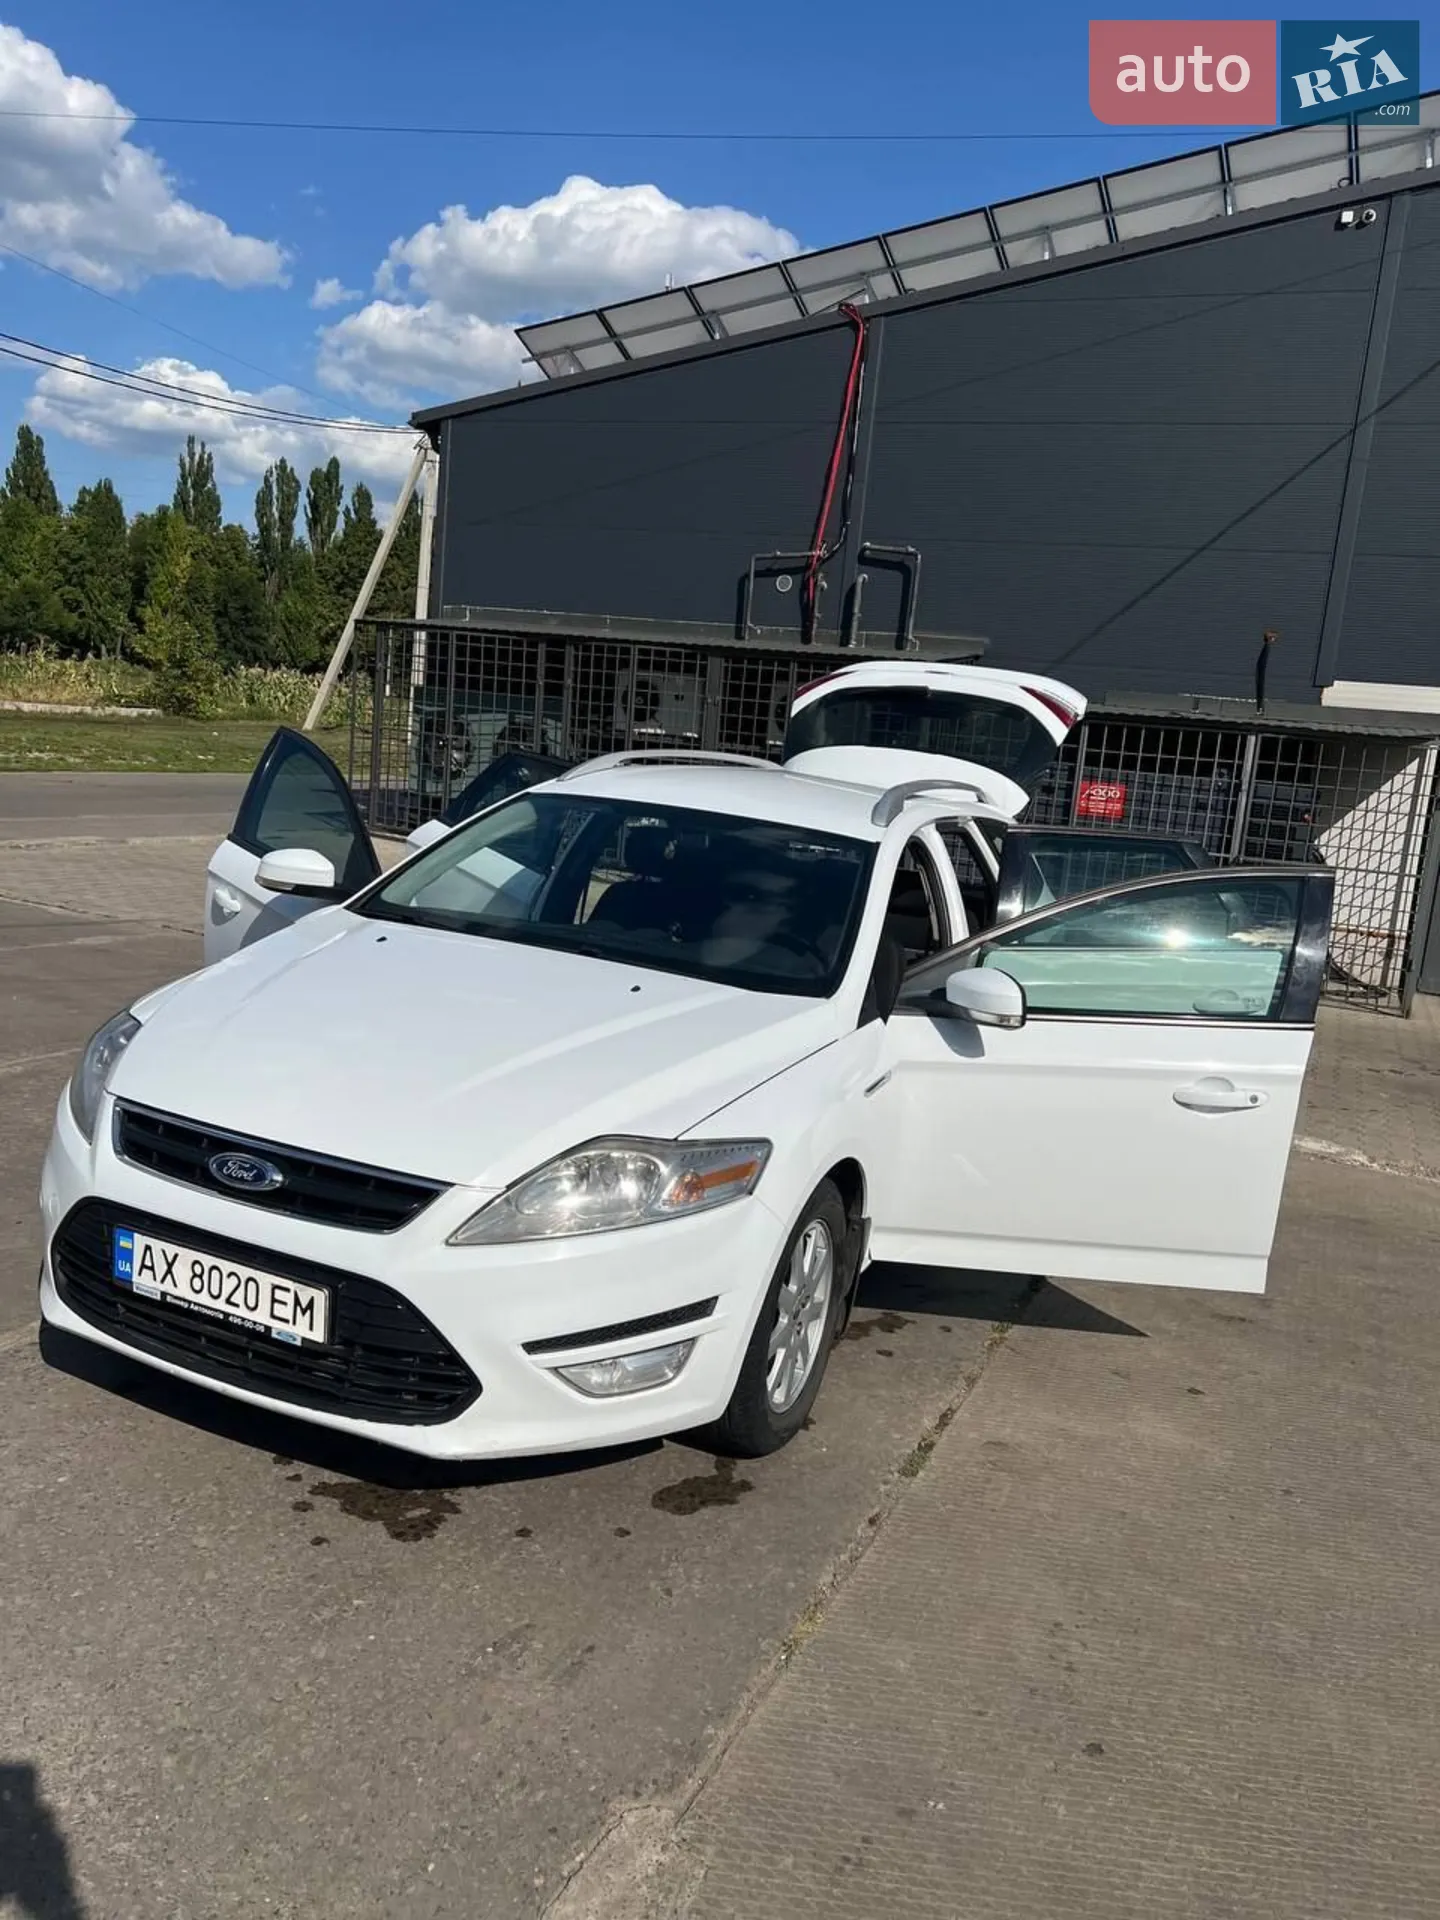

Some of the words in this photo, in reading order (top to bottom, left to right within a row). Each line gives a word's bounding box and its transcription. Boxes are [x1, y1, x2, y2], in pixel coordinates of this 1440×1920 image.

[223, 1160, 257, 1180] Ford
[118, 1259, 132, 1274] UA
[137, 1244, 180, 1288] AX
[189, 1259, 260, 1312] 8020
[269, 1283, 316, 1332] EM
